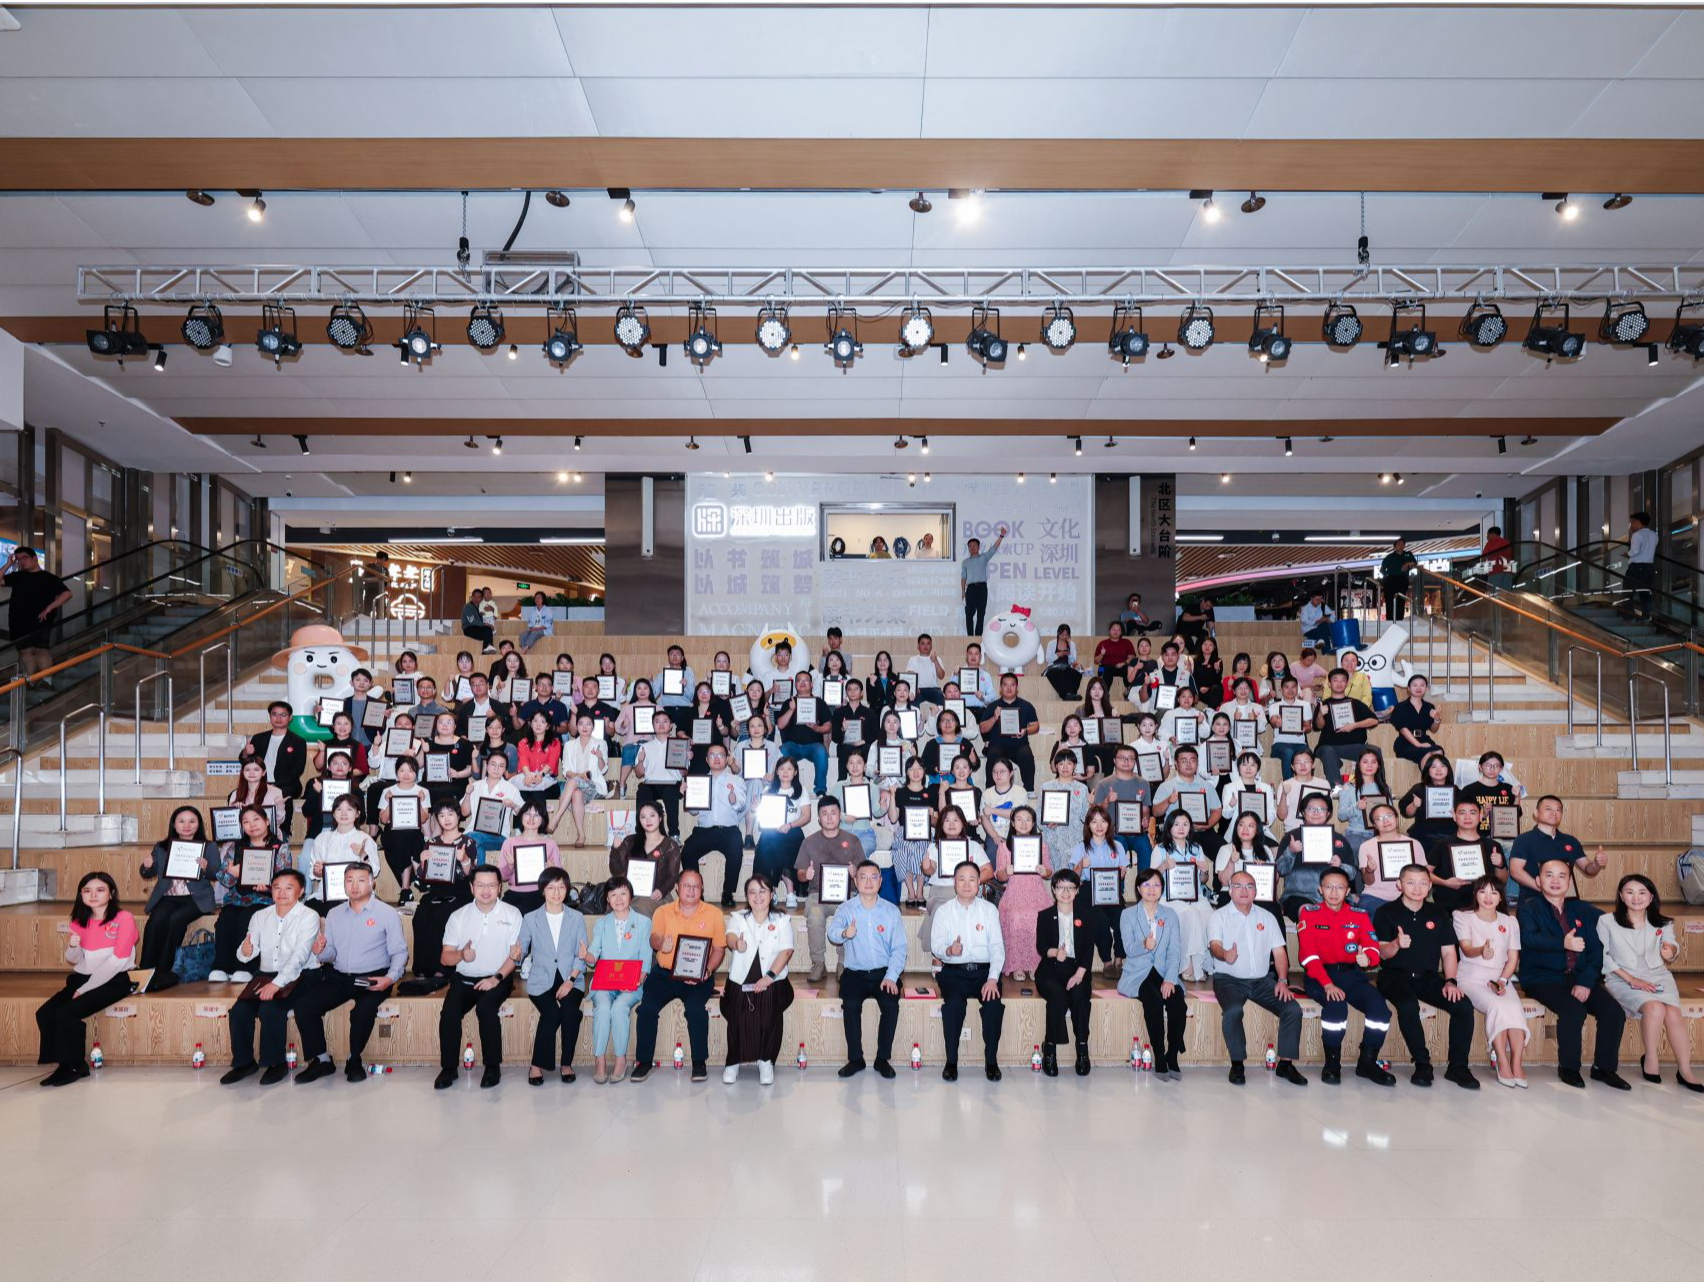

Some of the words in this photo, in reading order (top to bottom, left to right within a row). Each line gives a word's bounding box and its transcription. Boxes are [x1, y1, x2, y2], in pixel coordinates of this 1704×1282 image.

[730, 506, 814, 527] 深圳出版
[1158, 482, 1171, 558] 北区大台阶
[962, 520, 1025, 540] BOOK
[1036, 517, 1080, 540] 文化
[1040, 543, 1079, 565] 深圳
[987, 561, 1028, 580] PEN
[1033, 567, 1080, 580] LEVEL
[698, 602, 794, 616] ACCOMPANY
[908, 605, 949, 617] FIELD
